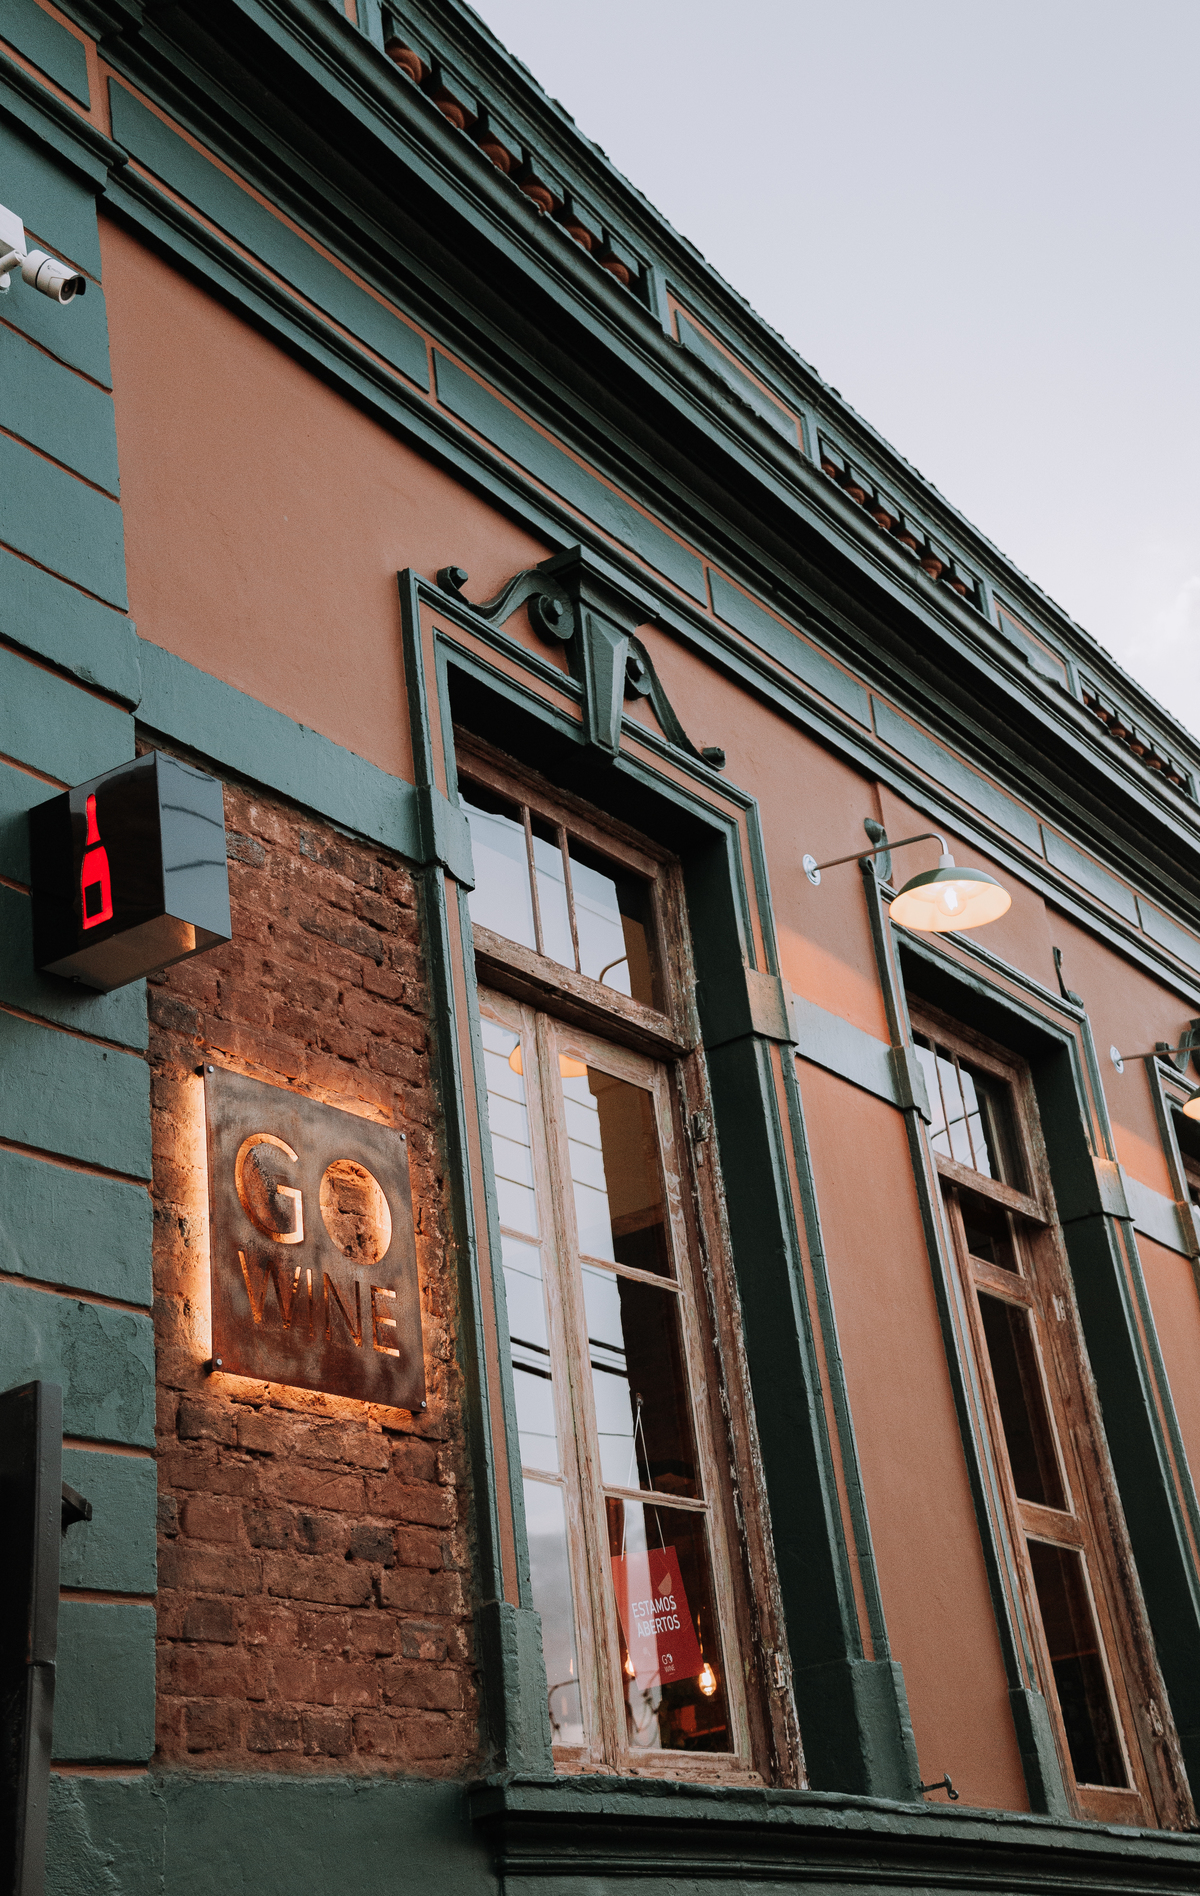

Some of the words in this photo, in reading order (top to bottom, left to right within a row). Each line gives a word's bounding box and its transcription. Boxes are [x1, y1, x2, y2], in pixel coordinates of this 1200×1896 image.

[234, 1132, 392, 1266] GO
[238, 1250, 400, 1357] WINE
[632, 1595, 677, 1618] ESTAMOS
[637, 1614, 681, 1637] ABERTOS
